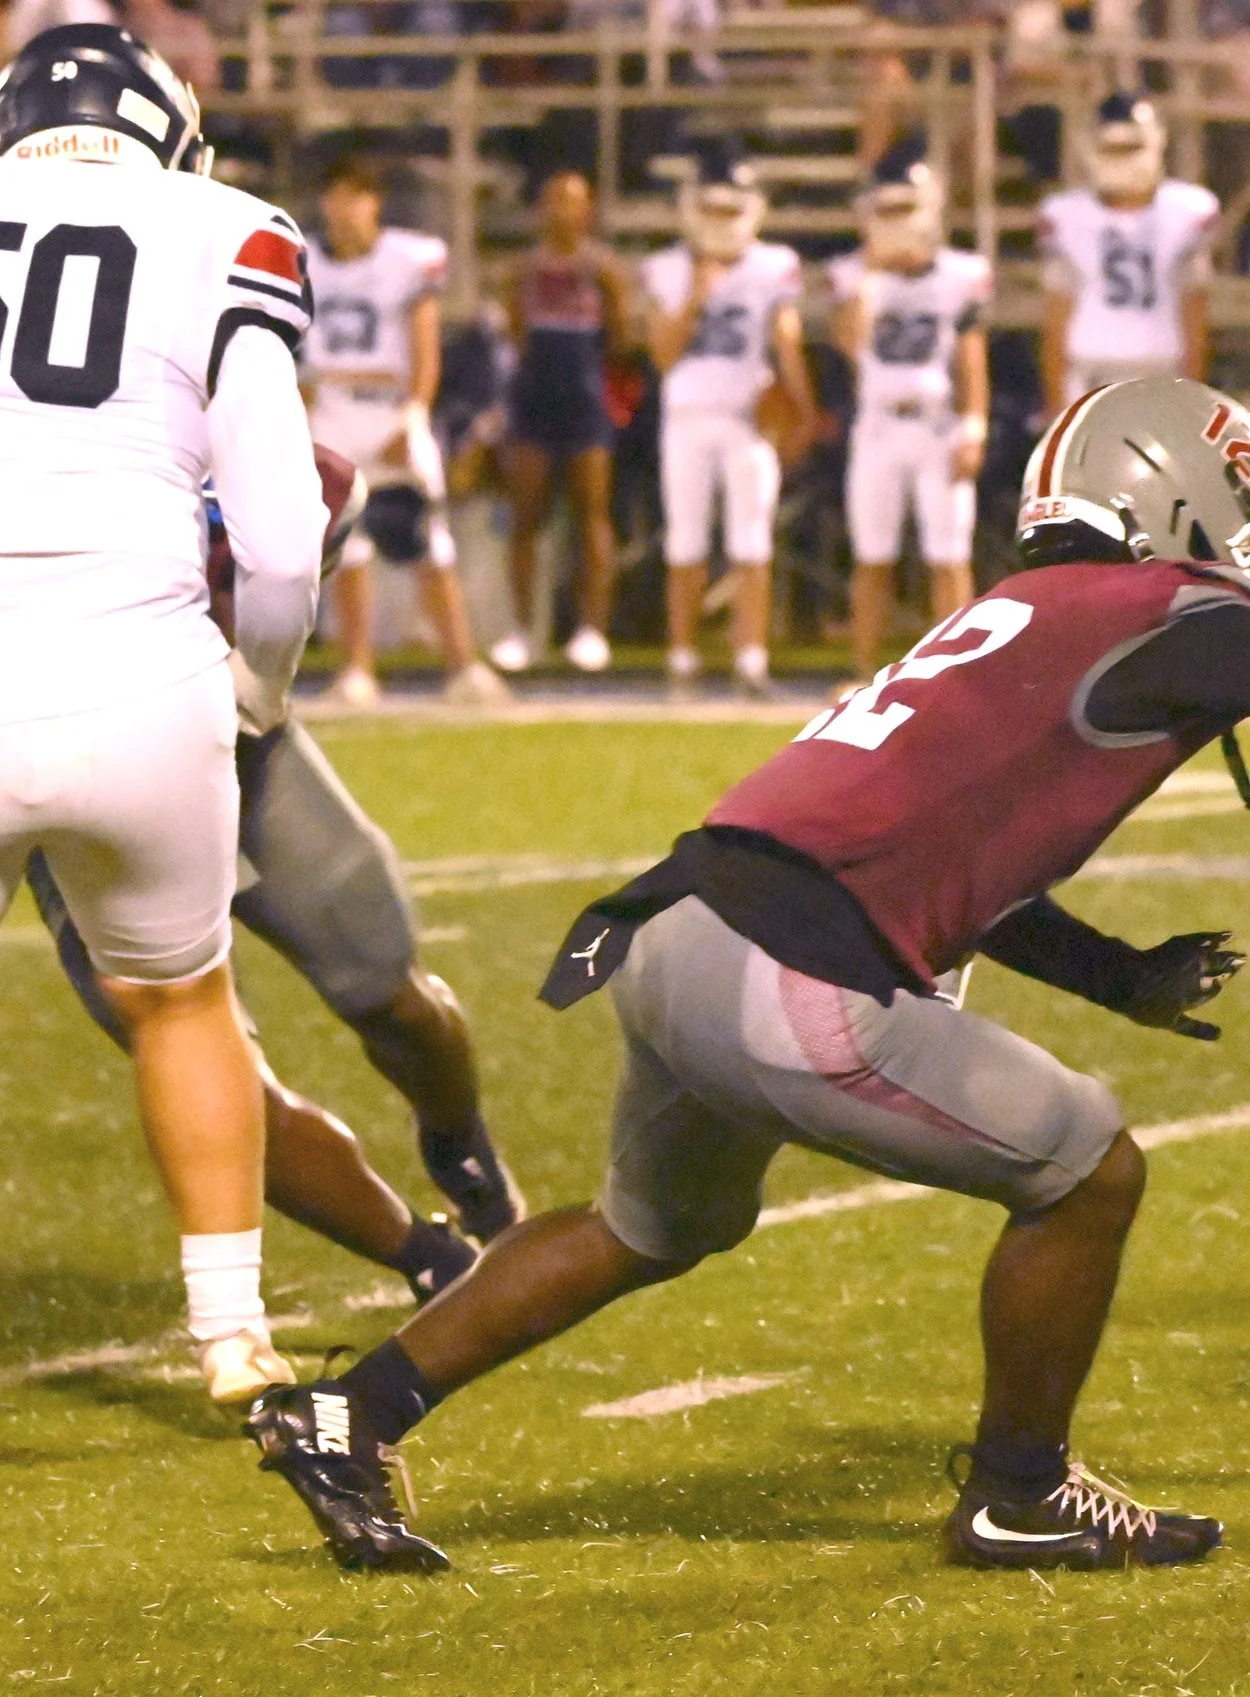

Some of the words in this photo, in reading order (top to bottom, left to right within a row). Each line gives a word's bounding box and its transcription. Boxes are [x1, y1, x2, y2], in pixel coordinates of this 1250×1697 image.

[51, 61, 78, 82] 50
[17, 134, 120, 159] Riddll
[0, 221, 137, 409] 0
